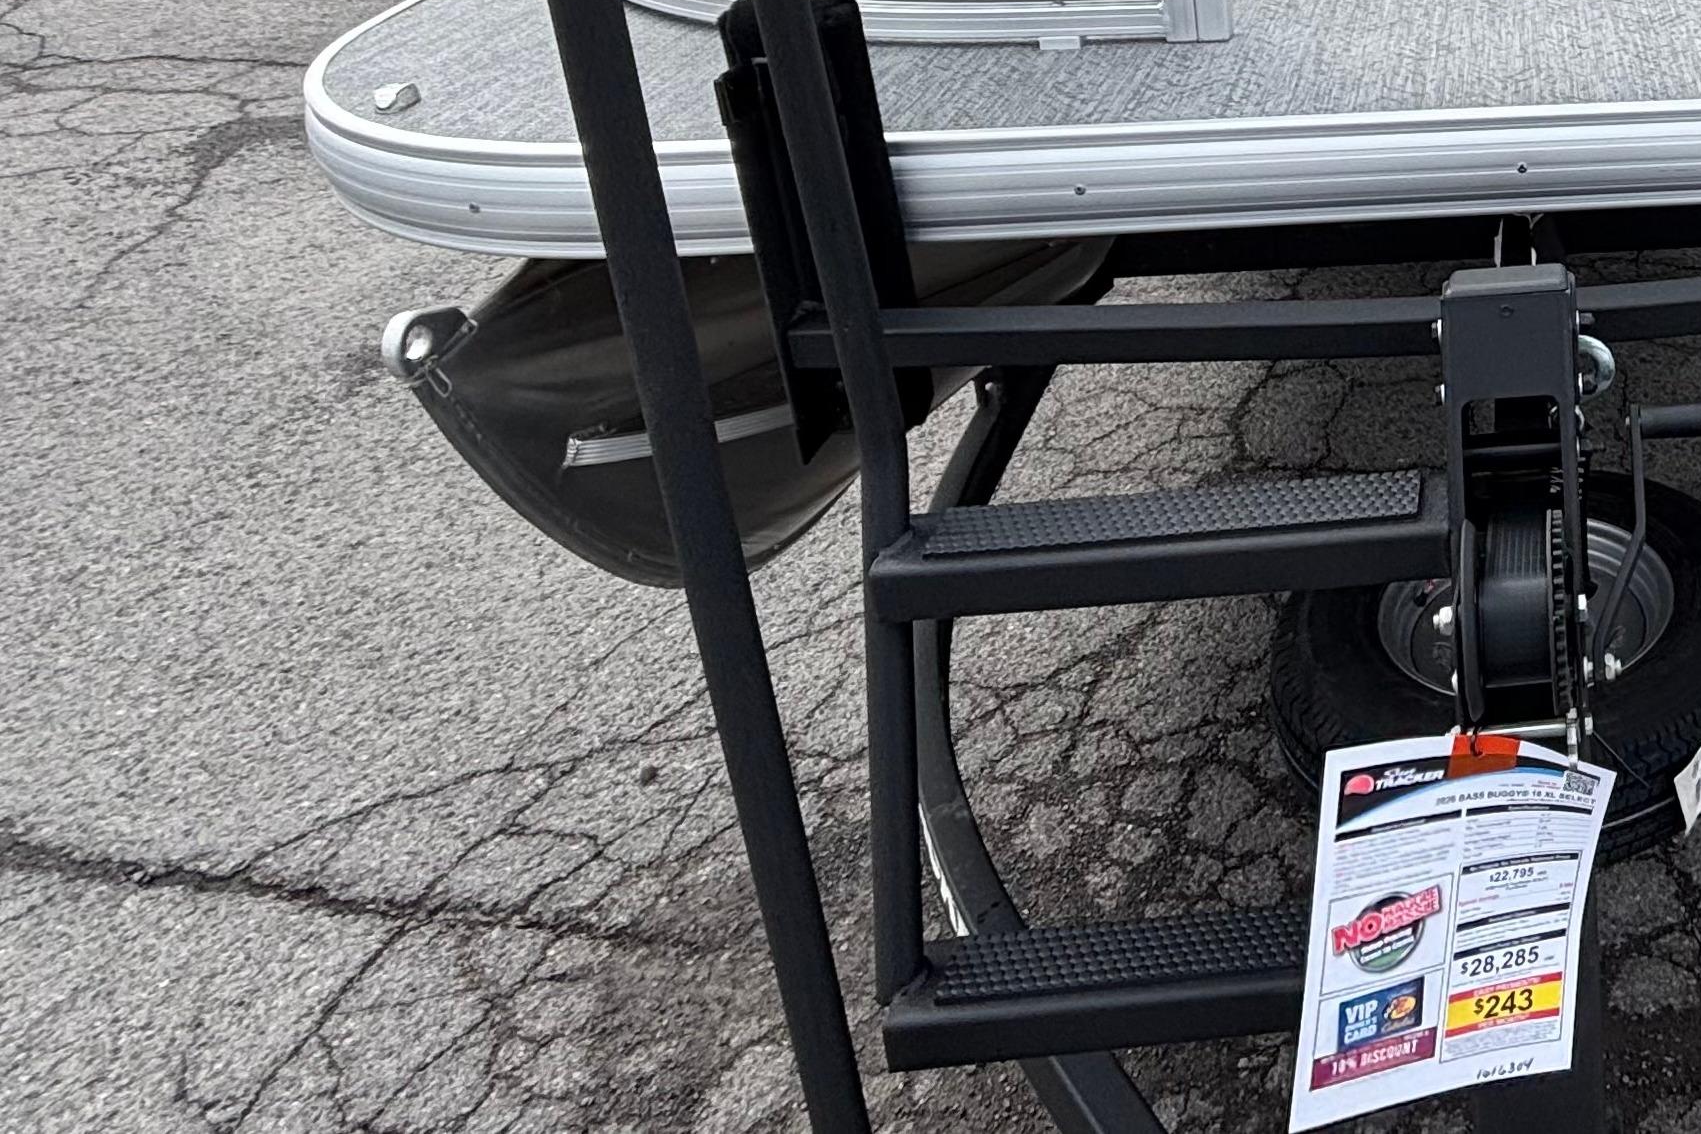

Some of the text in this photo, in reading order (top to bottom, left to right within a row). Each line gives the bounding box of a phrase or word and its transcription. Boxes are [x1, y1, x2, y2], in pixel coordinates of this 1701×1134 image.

[1375, 769, 1445, 791] TRACKER
[1458, 791, 1485, 803] BASS
[1558, 792, 1597, 805] SELECT
[1332, 912, 1383, 956] NO
[1460, 945, 1540, 977] $28,285
[1344, 999, 1379, 1024] VIP
[1473, 988, 1533, 1019] $243
[1360, 1039, 1419, 1067] DISCOUNT
